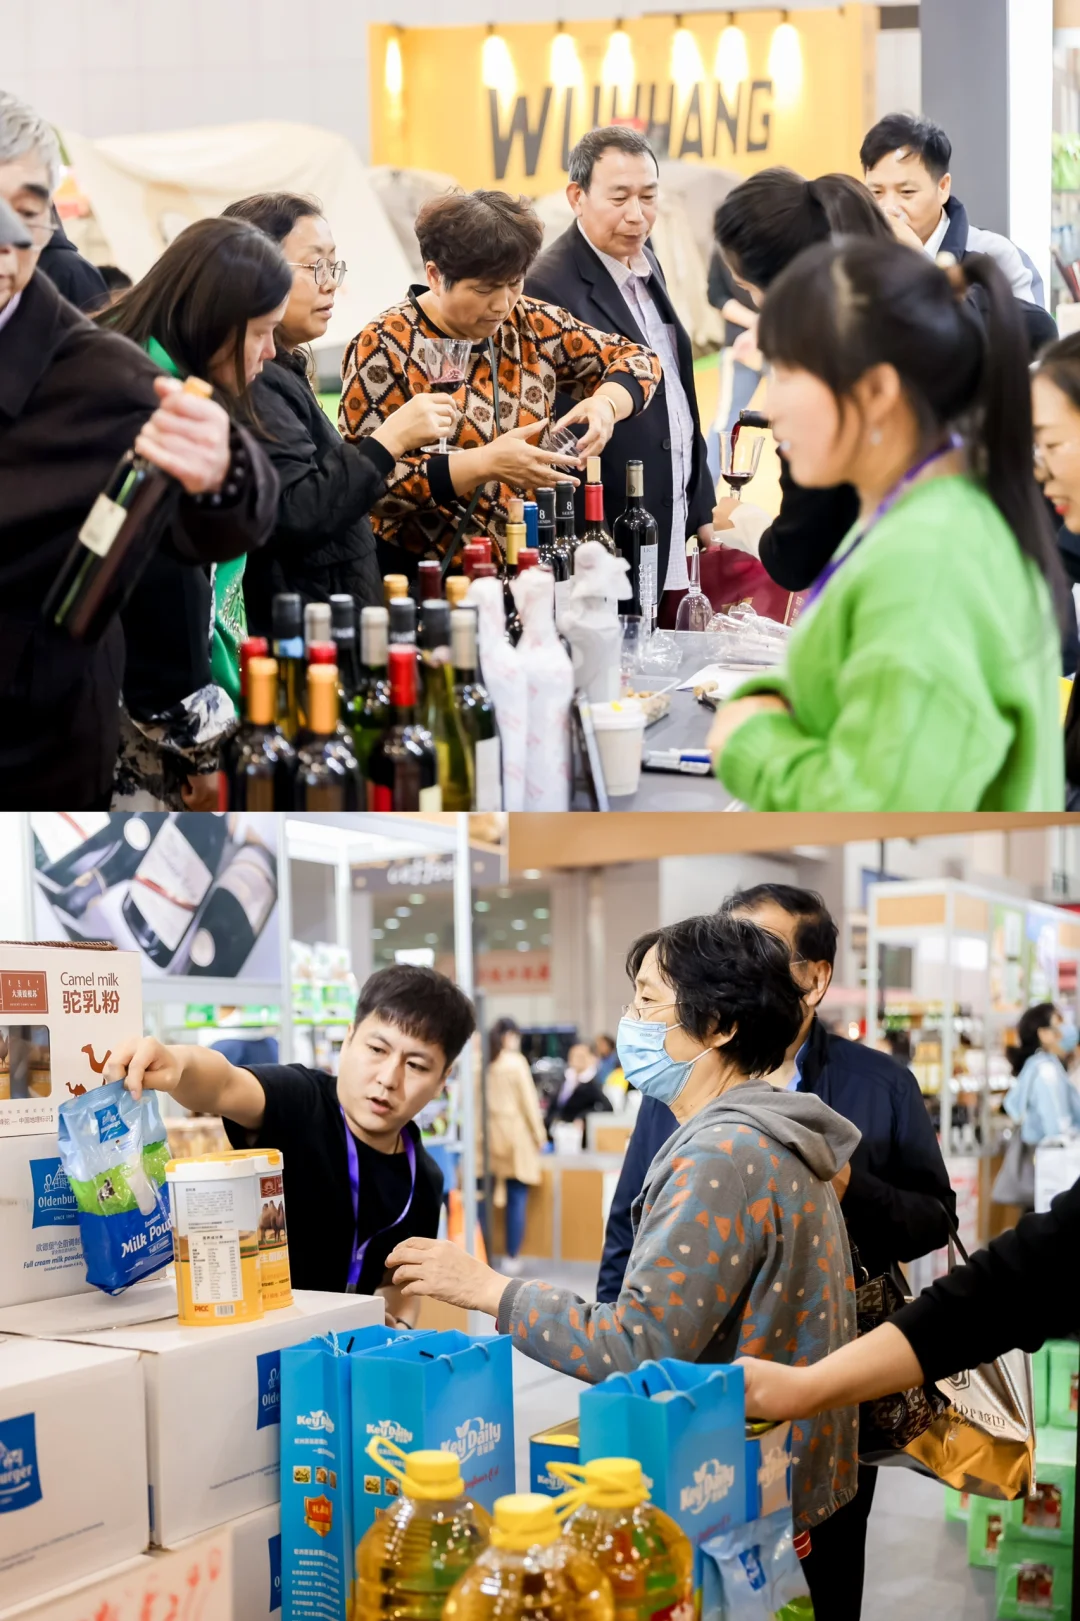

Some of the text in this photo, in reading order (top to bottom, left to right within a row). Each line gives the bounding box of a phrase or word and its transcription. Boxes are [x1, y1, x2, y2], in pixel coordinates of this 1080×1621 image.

[567, 501, 573, 511] 8
[539, 510, 546, 520] 8
[60, 972, 119, 986] Camel milk
[62, 990, 120, 1014] 驼乳粉
[38, 1194, 79, 1208] Oldenbur
[121, 1232, 147, 1258] Milk
[23, 1260, 34, 1269] Full
[34, 1259, 51, 1267] cream
[52, 1255, 63, 1264] milk
[468, 1422, 501, 1449] Daily
